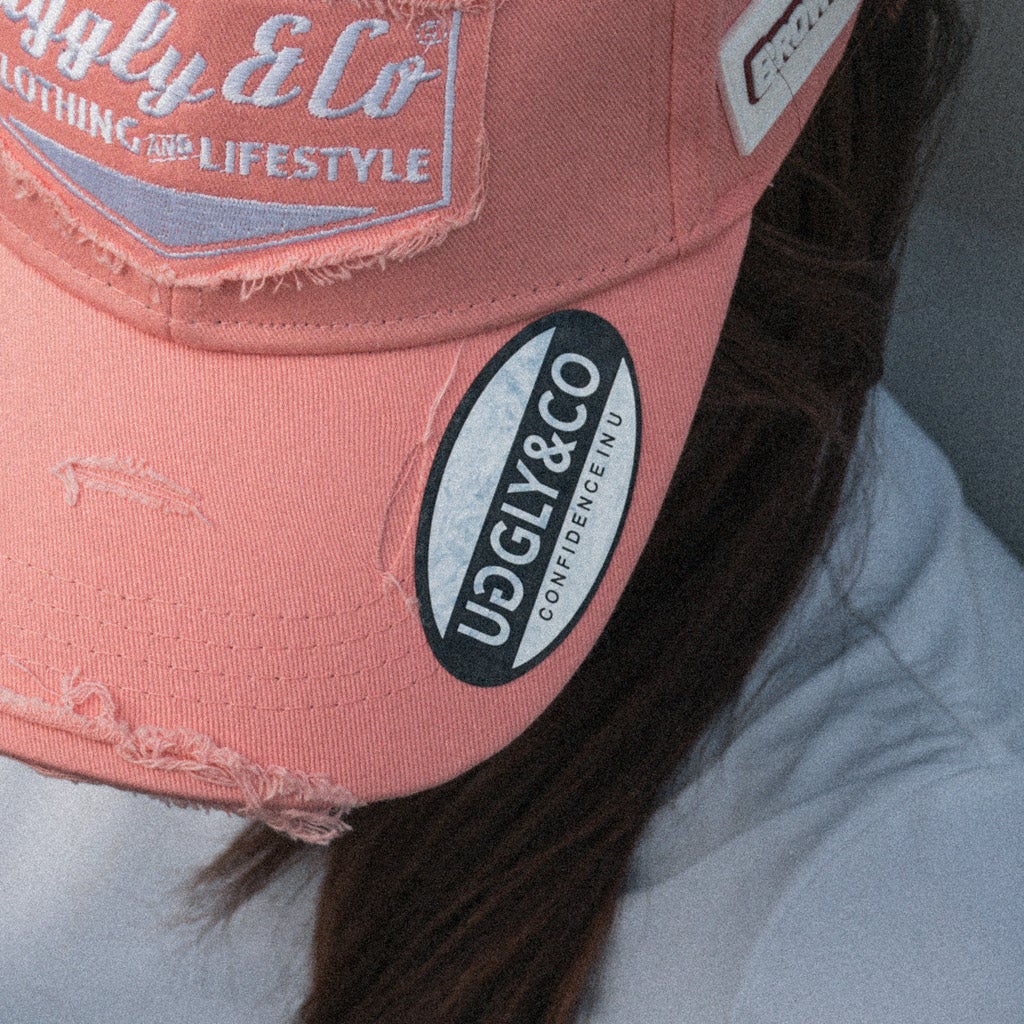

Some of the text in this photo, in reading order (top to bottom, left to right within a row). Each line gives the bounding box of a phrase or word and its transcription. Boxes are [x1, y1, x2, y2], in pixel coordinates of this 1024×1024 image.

[147, 133, 193, 163] AND
[199, 136, 431, 183] LIFESTYLE
[539, 462, 605, 622] CONFIDENCE
